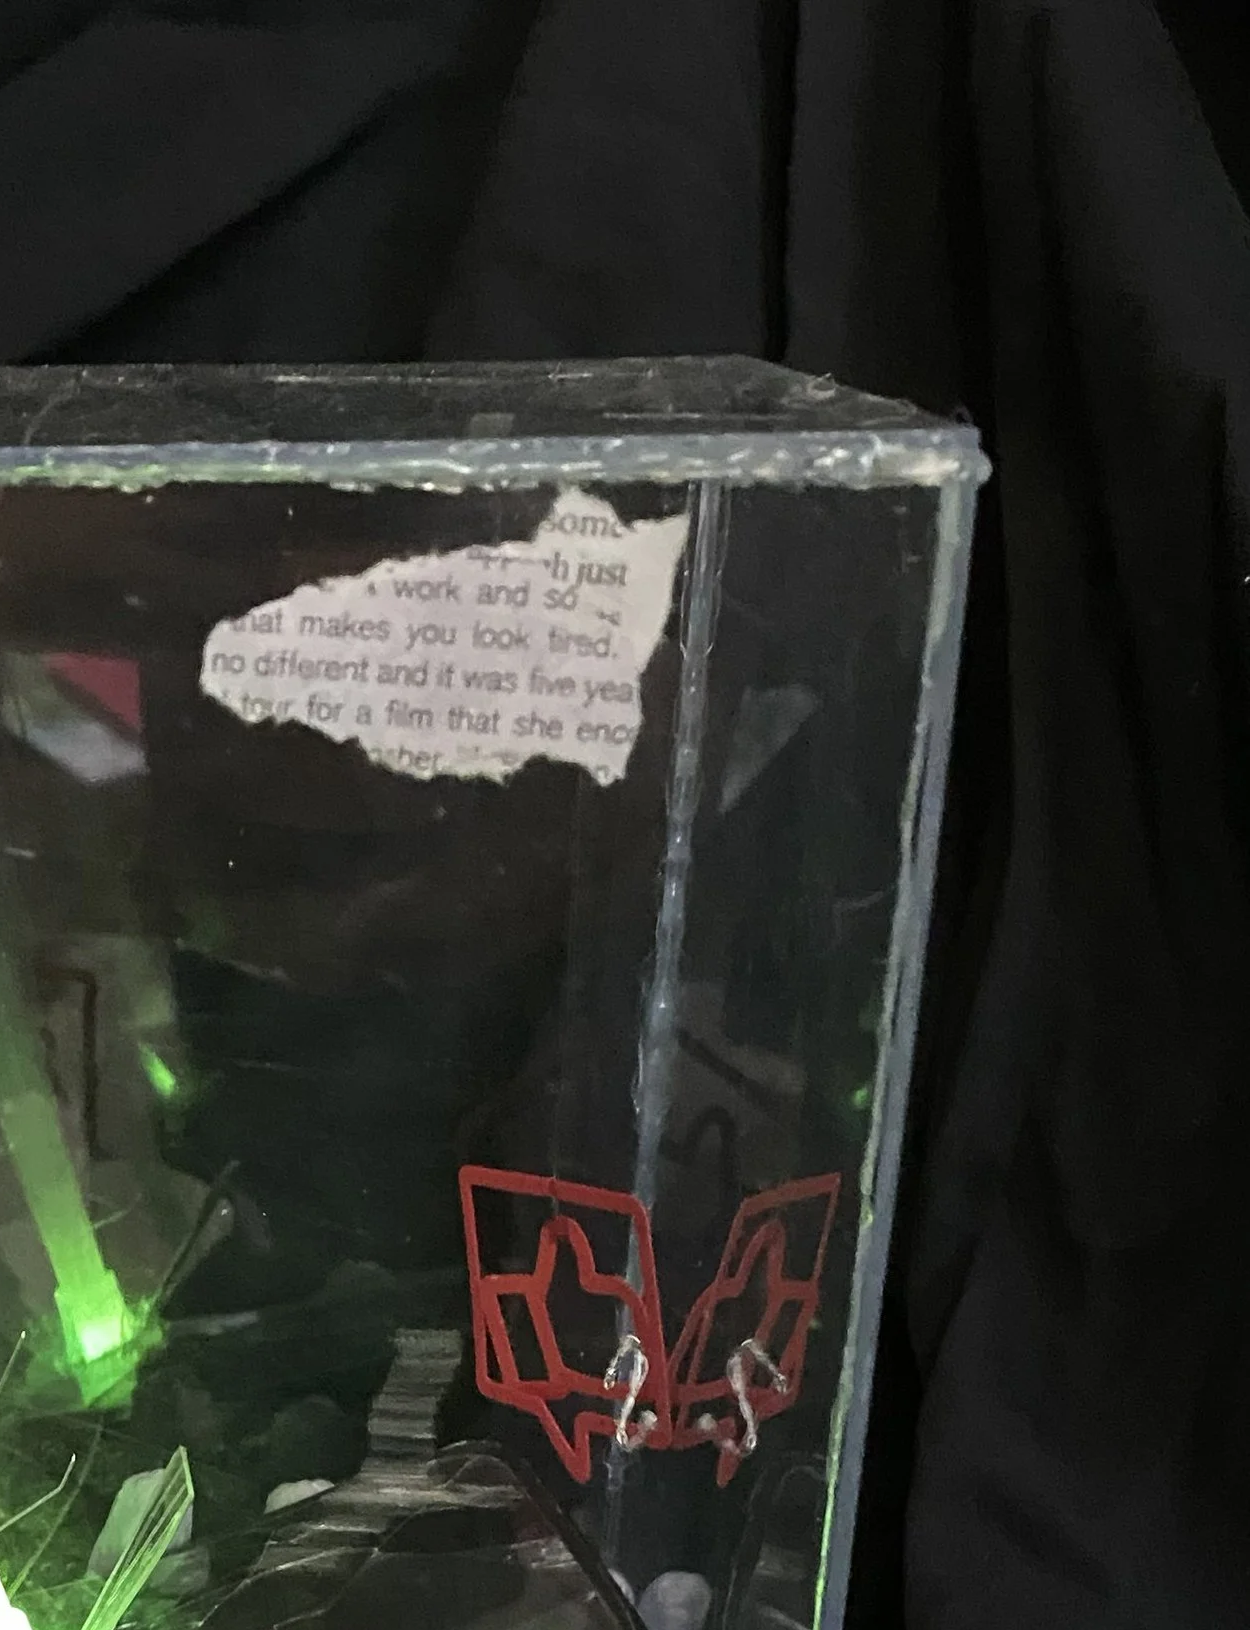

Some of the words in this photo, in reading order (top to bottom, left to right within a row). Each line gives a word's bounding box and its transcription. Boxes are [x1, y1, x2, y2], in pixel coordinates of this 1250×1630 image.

[393, 575, 460, 603] work
[478, 579, 531, 607] and
[543, 585, 579, 611] so
[576, 561, 628, 588] just
[299, 611, 391, 641] makes
[406, 621, 457, 650] you
[472, 620, 530, 650] look
[547, 626, 619, 660] tired.
[210, 652, 246, 675] no
[253, 647, 369, 684] different
[376, 660, 428, 687] and
[435, 664, 454, 690] it
[462, 669, 519, 695] was
[528, 666, 577, 697] five
[306, 694, 344, 723] for
[355, 703, 372, 726] a
[384, 699, 434, 729] film
[447, 705, 500, 735] that
[513, 710, 564, 740] she
